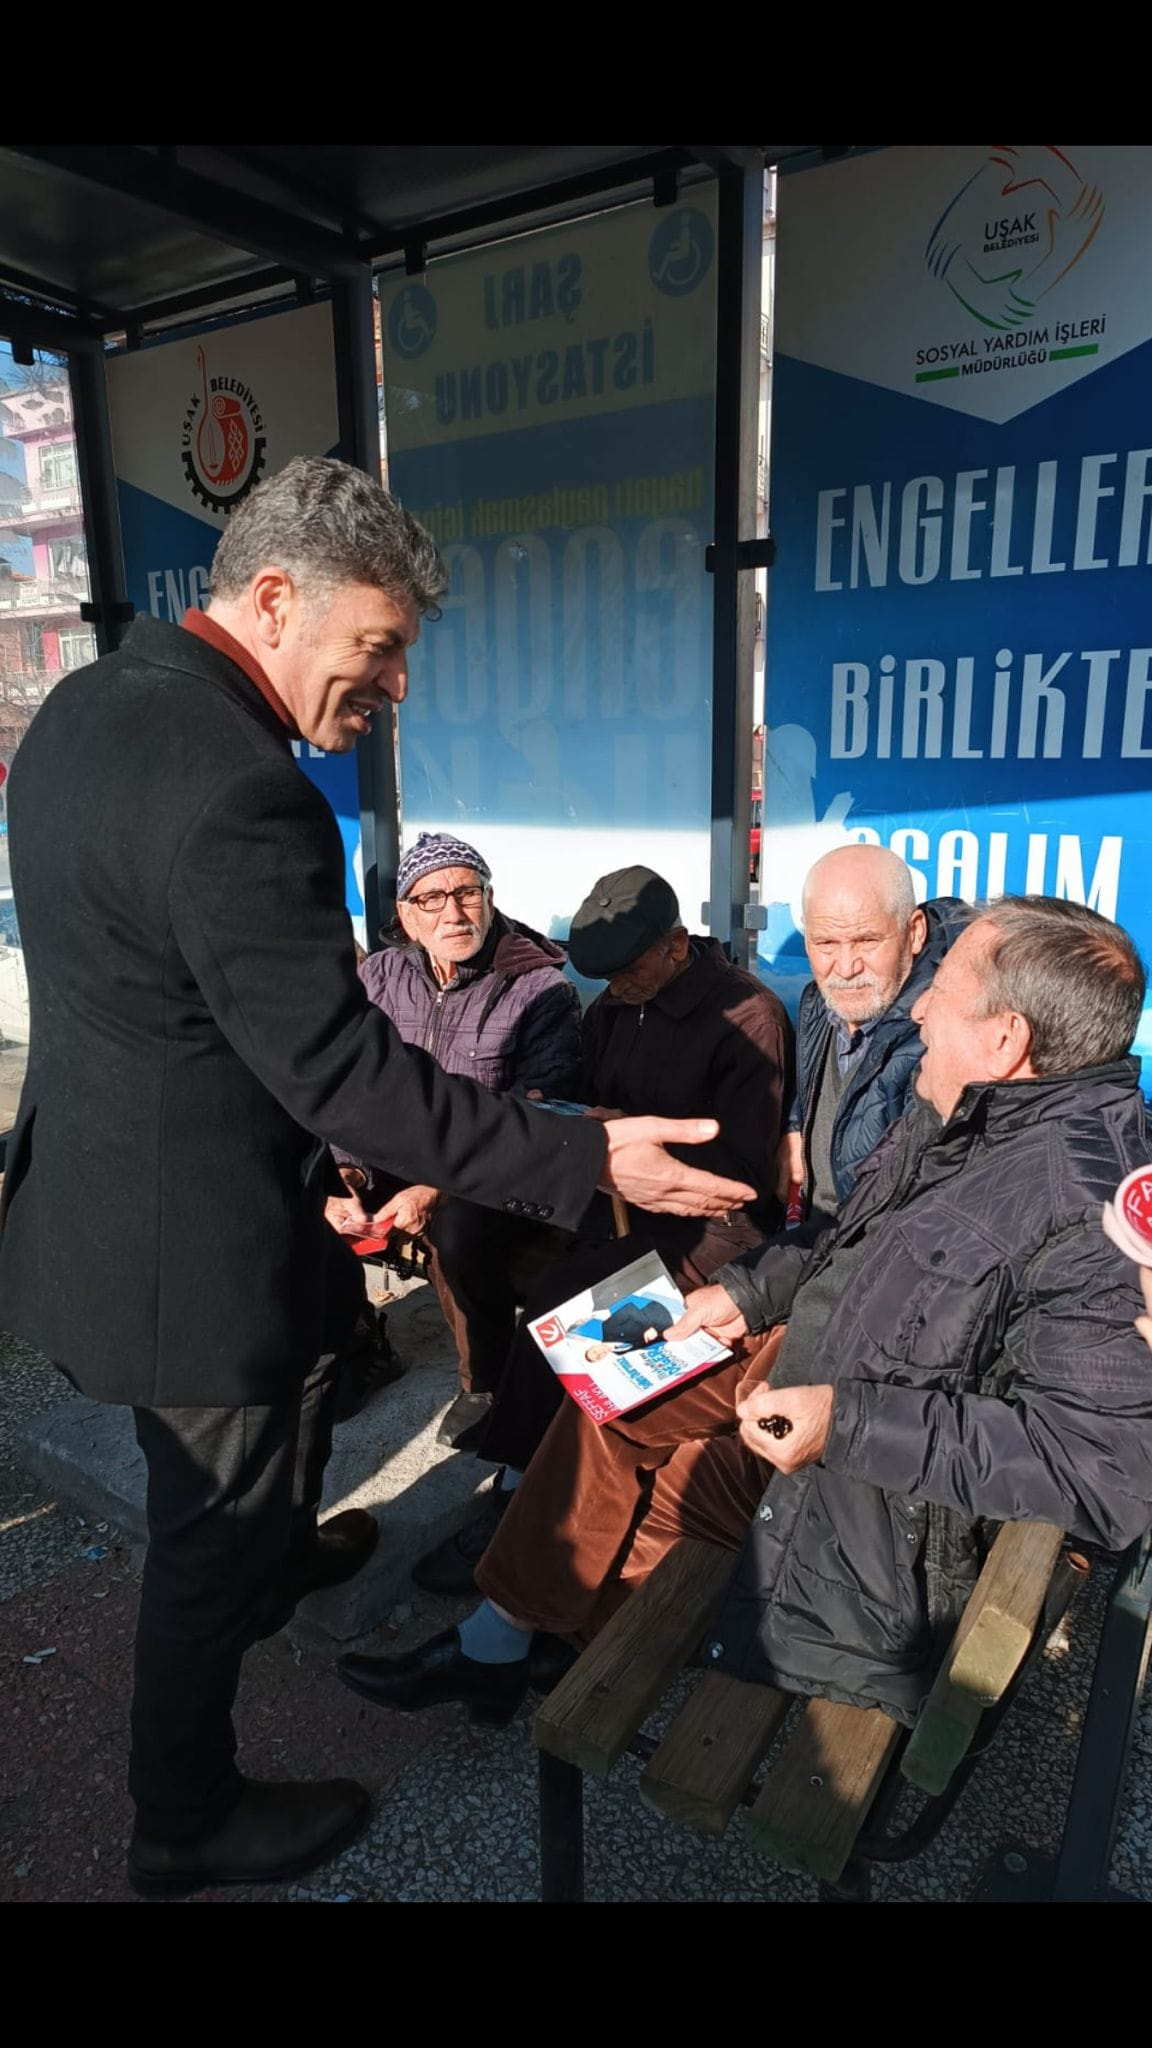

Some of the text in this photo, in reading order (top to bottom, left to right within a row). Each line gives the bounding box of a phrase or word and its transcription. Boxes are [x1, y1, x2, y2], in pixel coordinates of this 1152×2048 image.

[984, 212, 1037, 241] UŞAK
[983, 233, 1040, 252] BELEDİYESİ
[915, 313, 1106, 366] SOSYAL YARDIM İŞLERİ
[961, 350, 1047, 377] MÜDÜRLÜĞÜ
[209, 376, 267, 433] BELEDİYESİ
